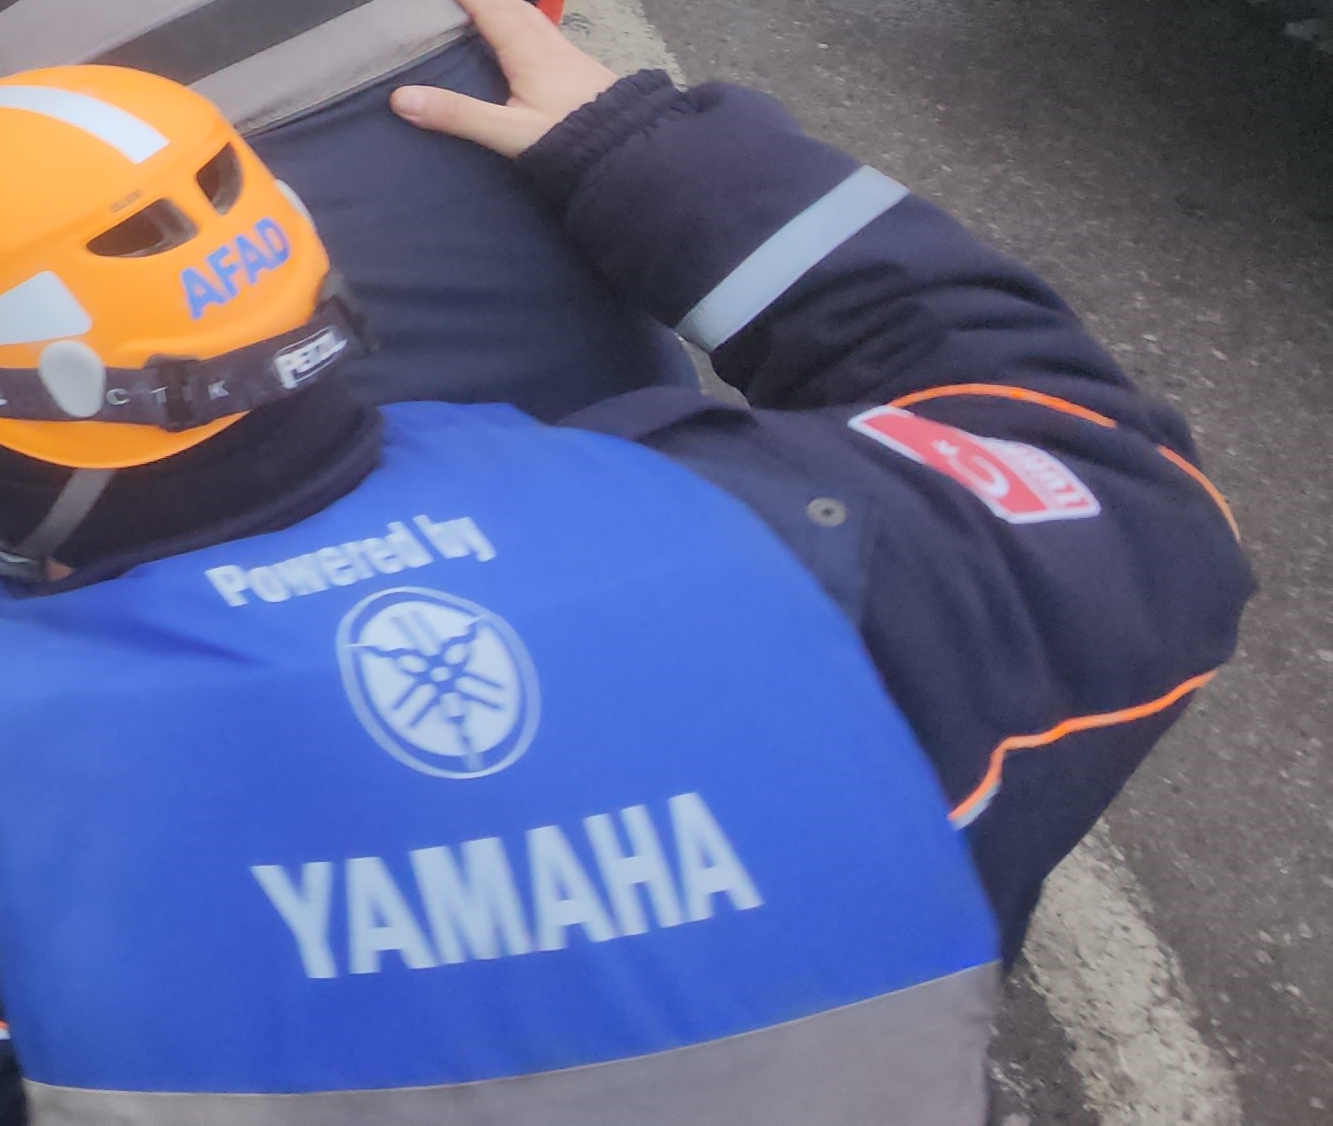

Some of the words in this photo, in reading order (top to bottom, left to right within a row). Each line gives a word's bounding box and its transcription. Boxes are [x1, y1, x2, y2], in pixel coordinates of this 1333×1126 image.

[179, 216, 291, 321] AFAD
[203, 520, 434, 607] Powered
[412, 513, 497, 563] by
[249, 791, 766, 979] YAMAHA
